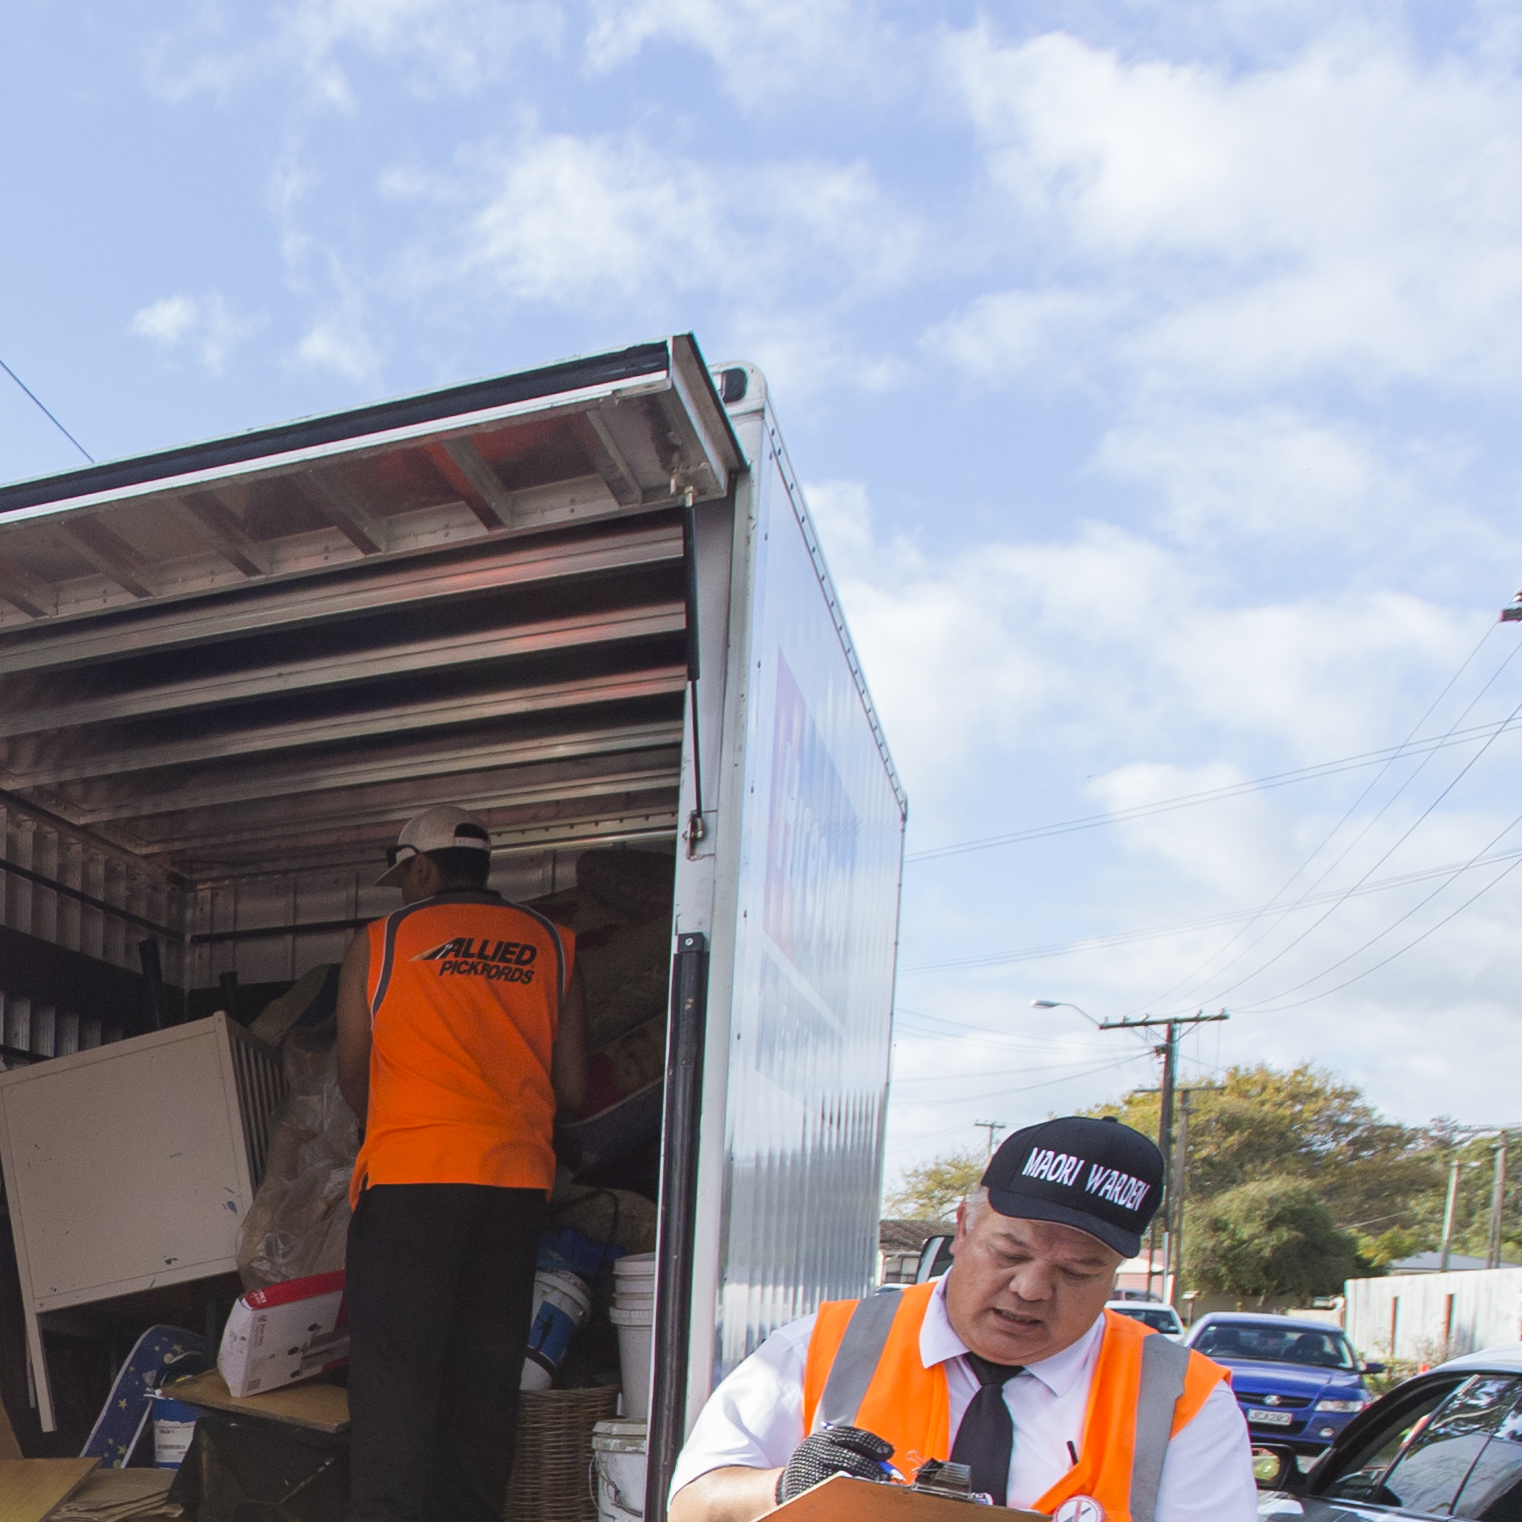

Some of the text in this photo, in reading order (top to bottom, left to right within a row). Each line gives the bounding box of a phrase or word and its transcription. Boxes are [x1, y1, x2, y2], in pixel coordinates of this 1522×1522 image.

[422, 937, 538, 966] ALLIED
[438, 960, 535, 985] PICKFORDS
[1021, 1147, 1152, 1212] MAORI WARDEN
